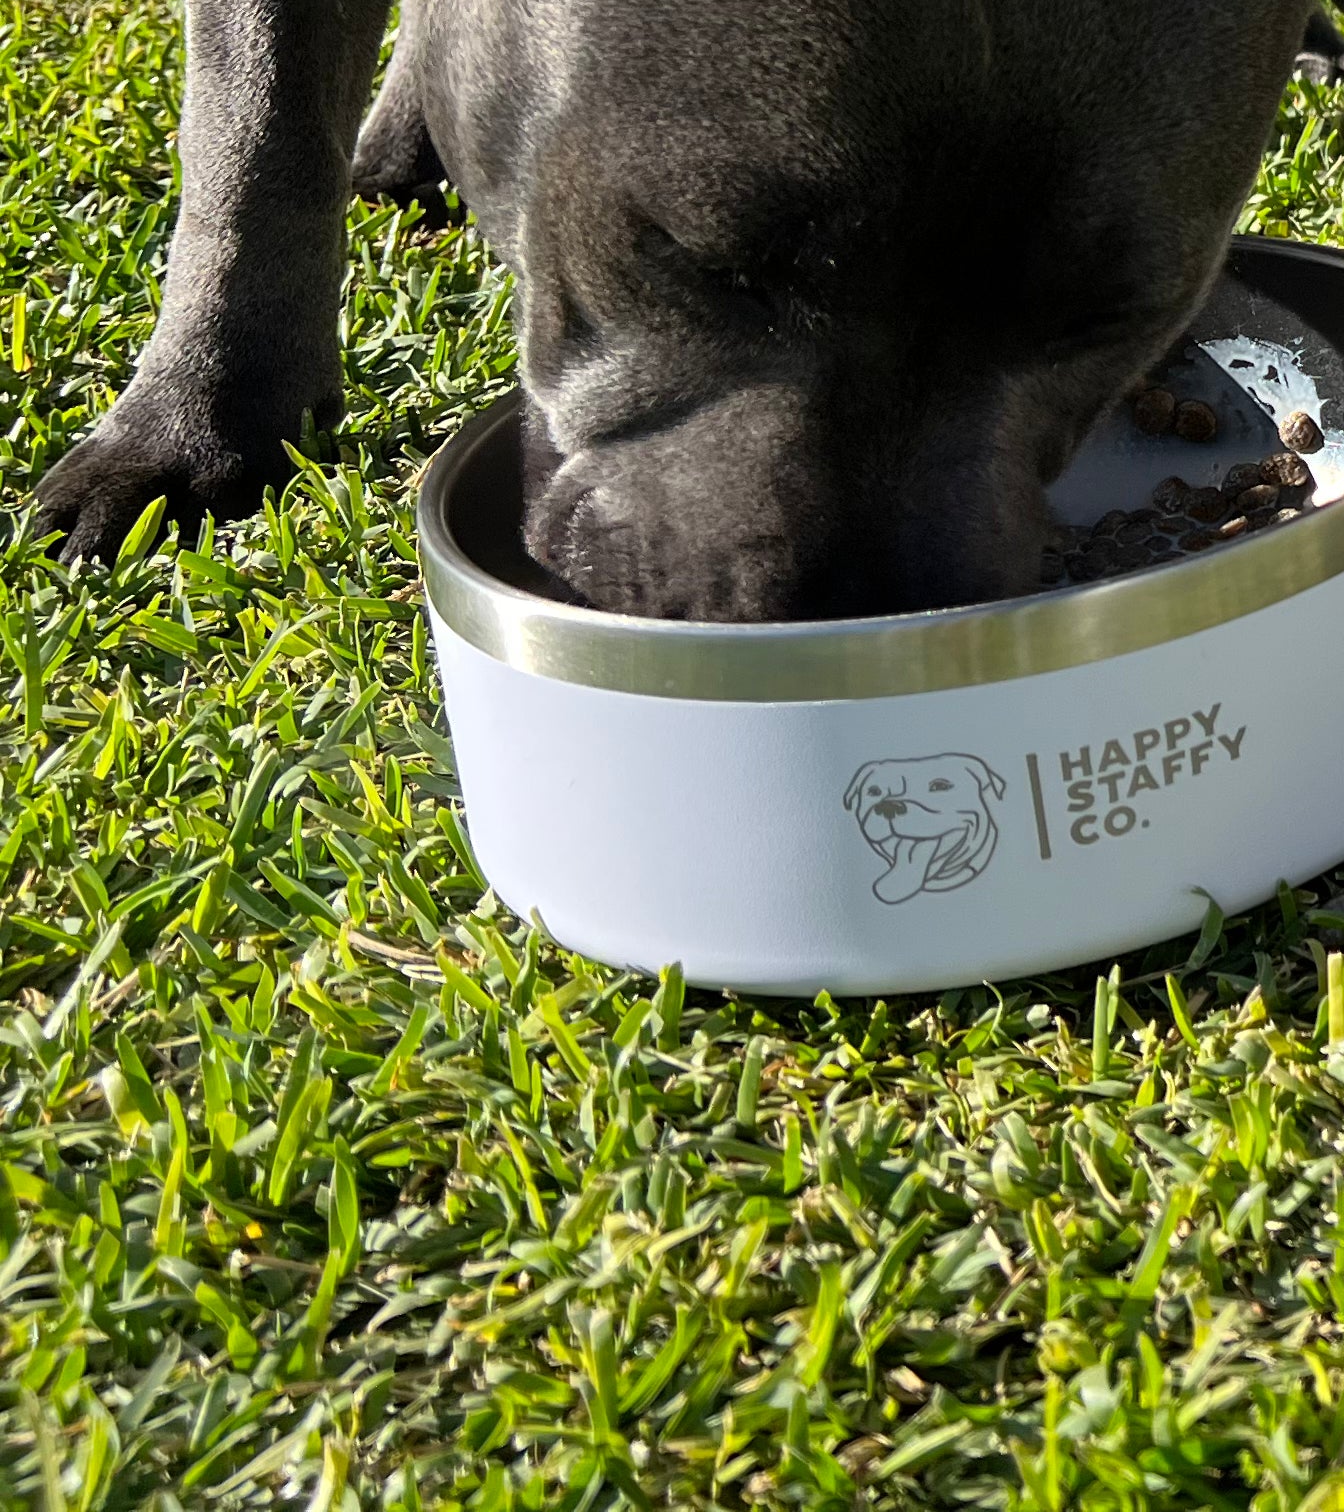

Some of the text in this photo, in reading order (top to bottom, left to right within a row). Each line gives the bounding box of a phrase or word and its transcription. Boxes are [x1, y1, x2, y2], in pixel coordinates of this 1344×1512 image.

[1060, 703, 1222, 782] HAPPY
[1067, 726, 1246, 813] STAFFY
[1070, 806, 1150, 846] CO.
